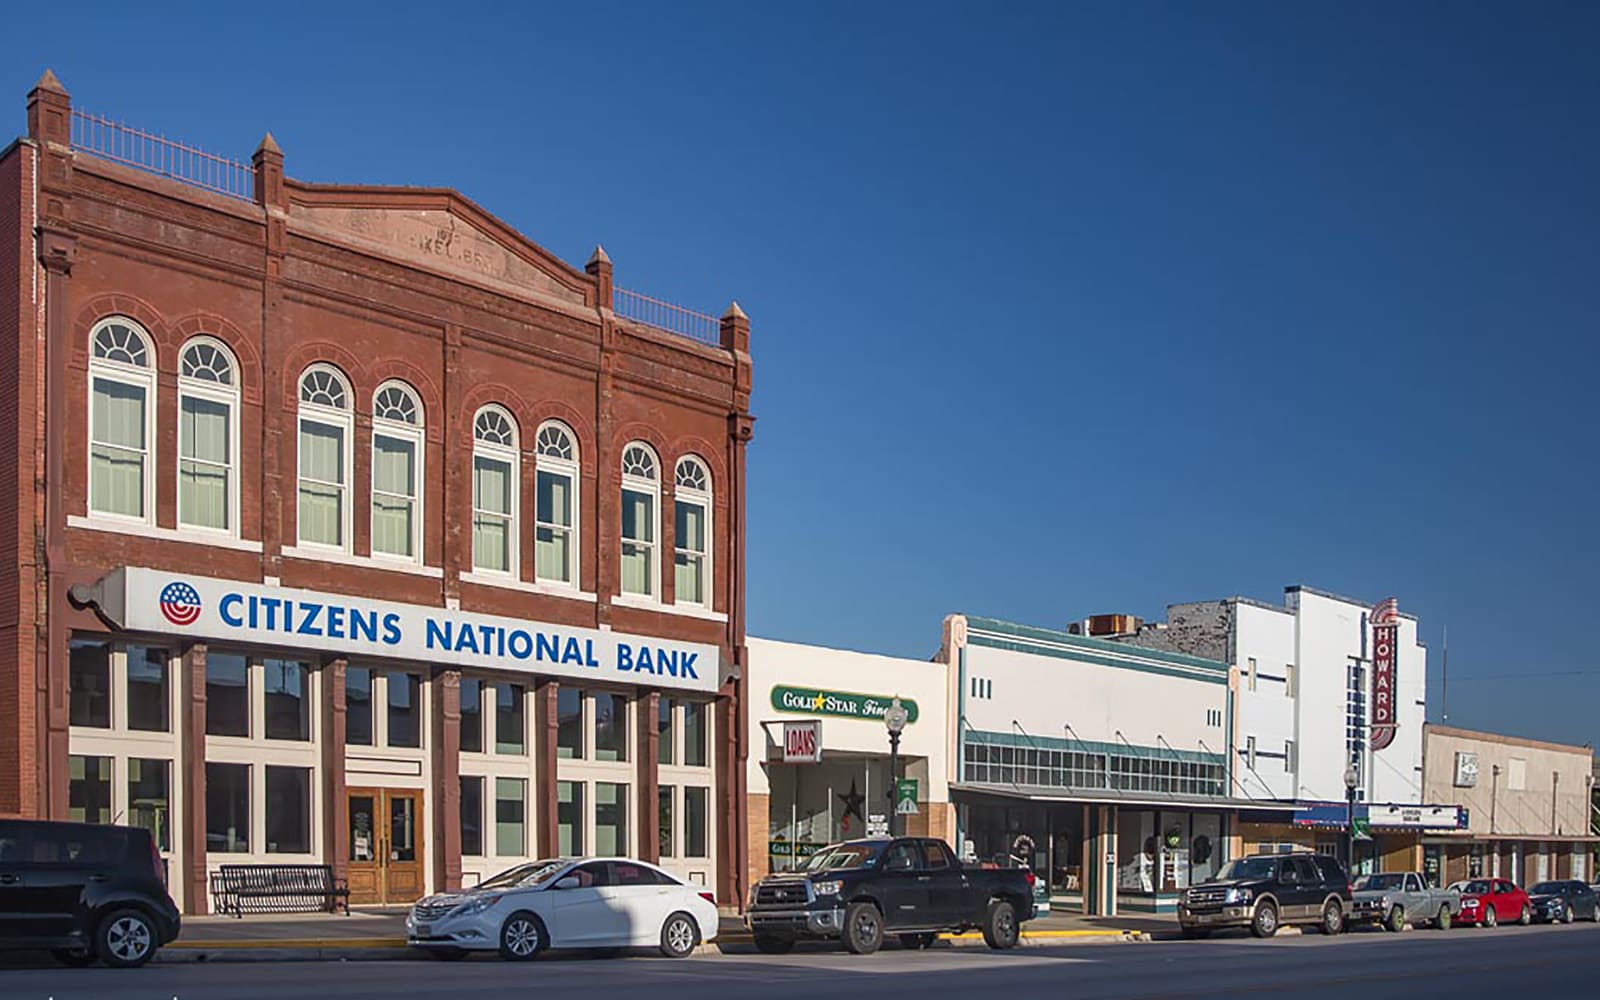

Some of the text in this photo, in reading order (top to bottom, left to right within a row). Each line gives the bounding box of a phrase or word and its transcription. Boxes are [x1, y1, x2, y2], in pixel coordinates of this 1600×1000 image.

[219, 593, 699, 680] CITIZENS NATIONAL BANK
[1377, 628, 1389, 720] HOWARD
[786, 730, 816, 756] LOANS
